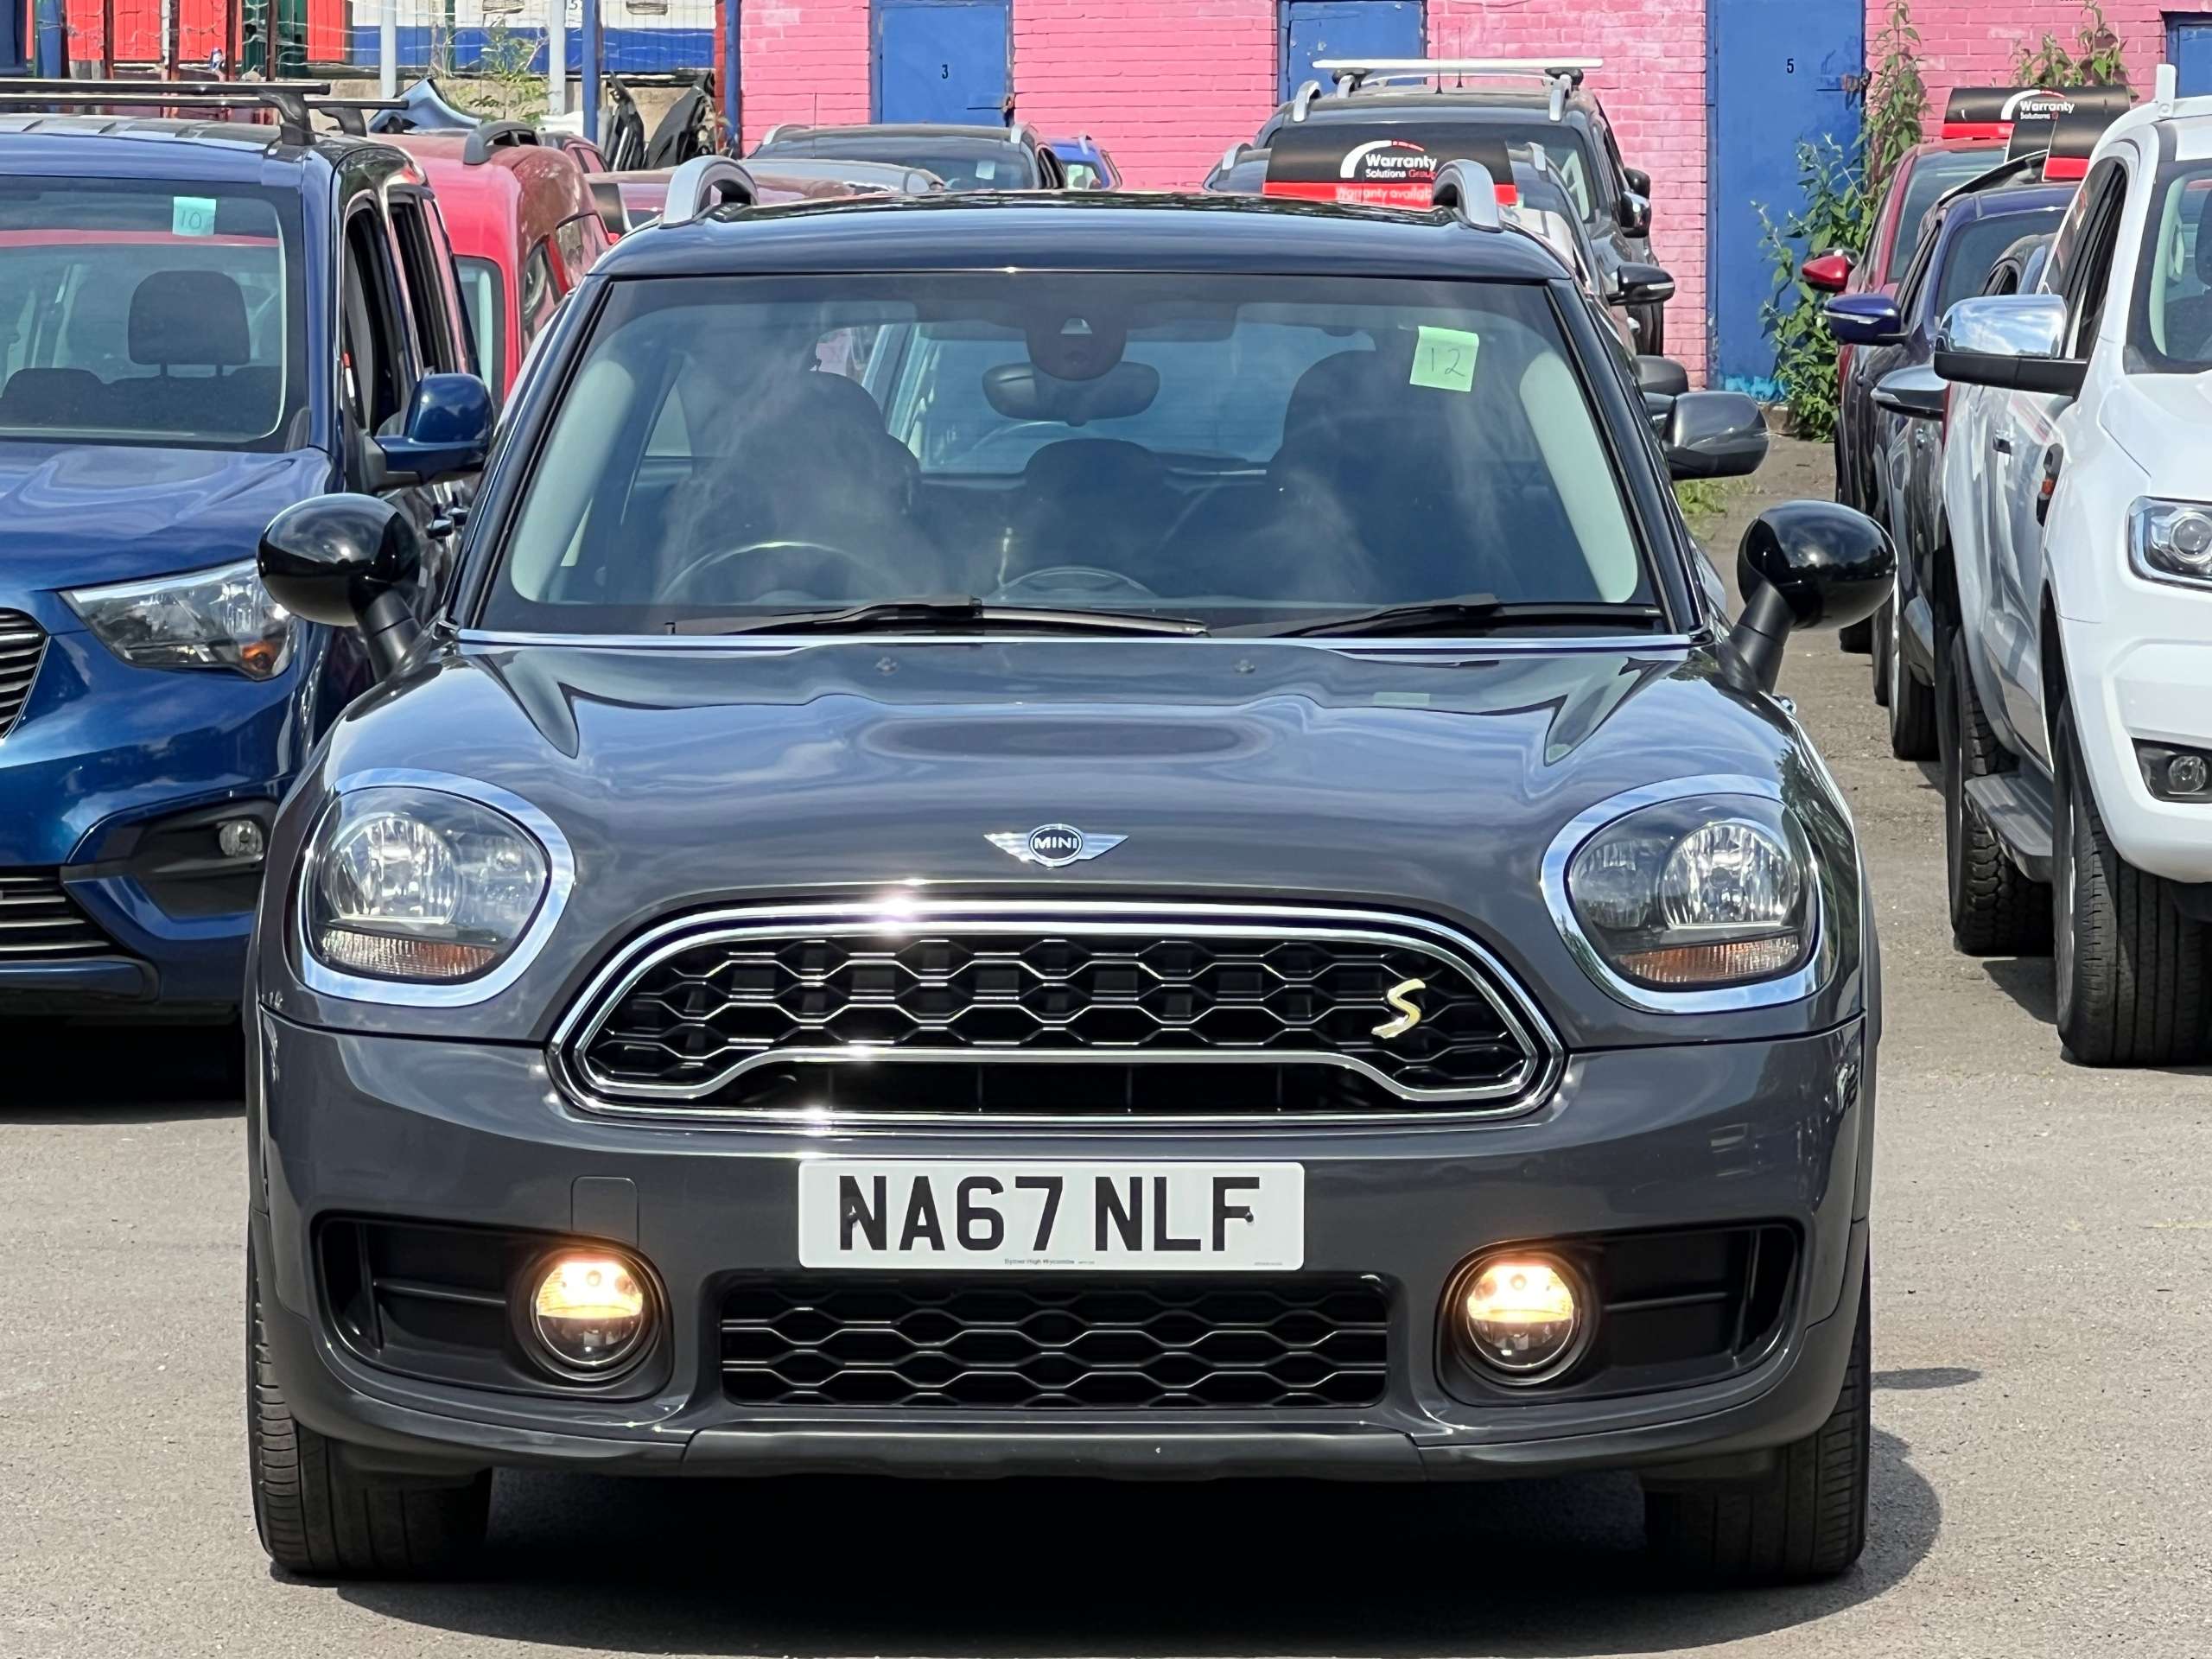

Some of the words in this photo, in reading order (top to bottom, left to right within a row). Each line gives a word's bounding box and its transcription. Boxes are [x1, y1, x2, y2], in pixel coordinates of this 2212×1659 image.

[942, 64, 949, 79] 3
[1787, 58, 1795, 73] 5
[2019, 100, 2075, 114] Warranty
[1365, 154, 1438, 172] Warranty
[1365, 168, 1407, 179] Solutions
[181, 209, 202, 230] 10
[1431, 346, 1466, 377] 12
[1033, 836, 1078, 849] MINI
[1370, 978, 1427, 1039] S
[839, 1175, 1064, 1252] NA67
[1095, 1175, 1260, 1253] NLF
